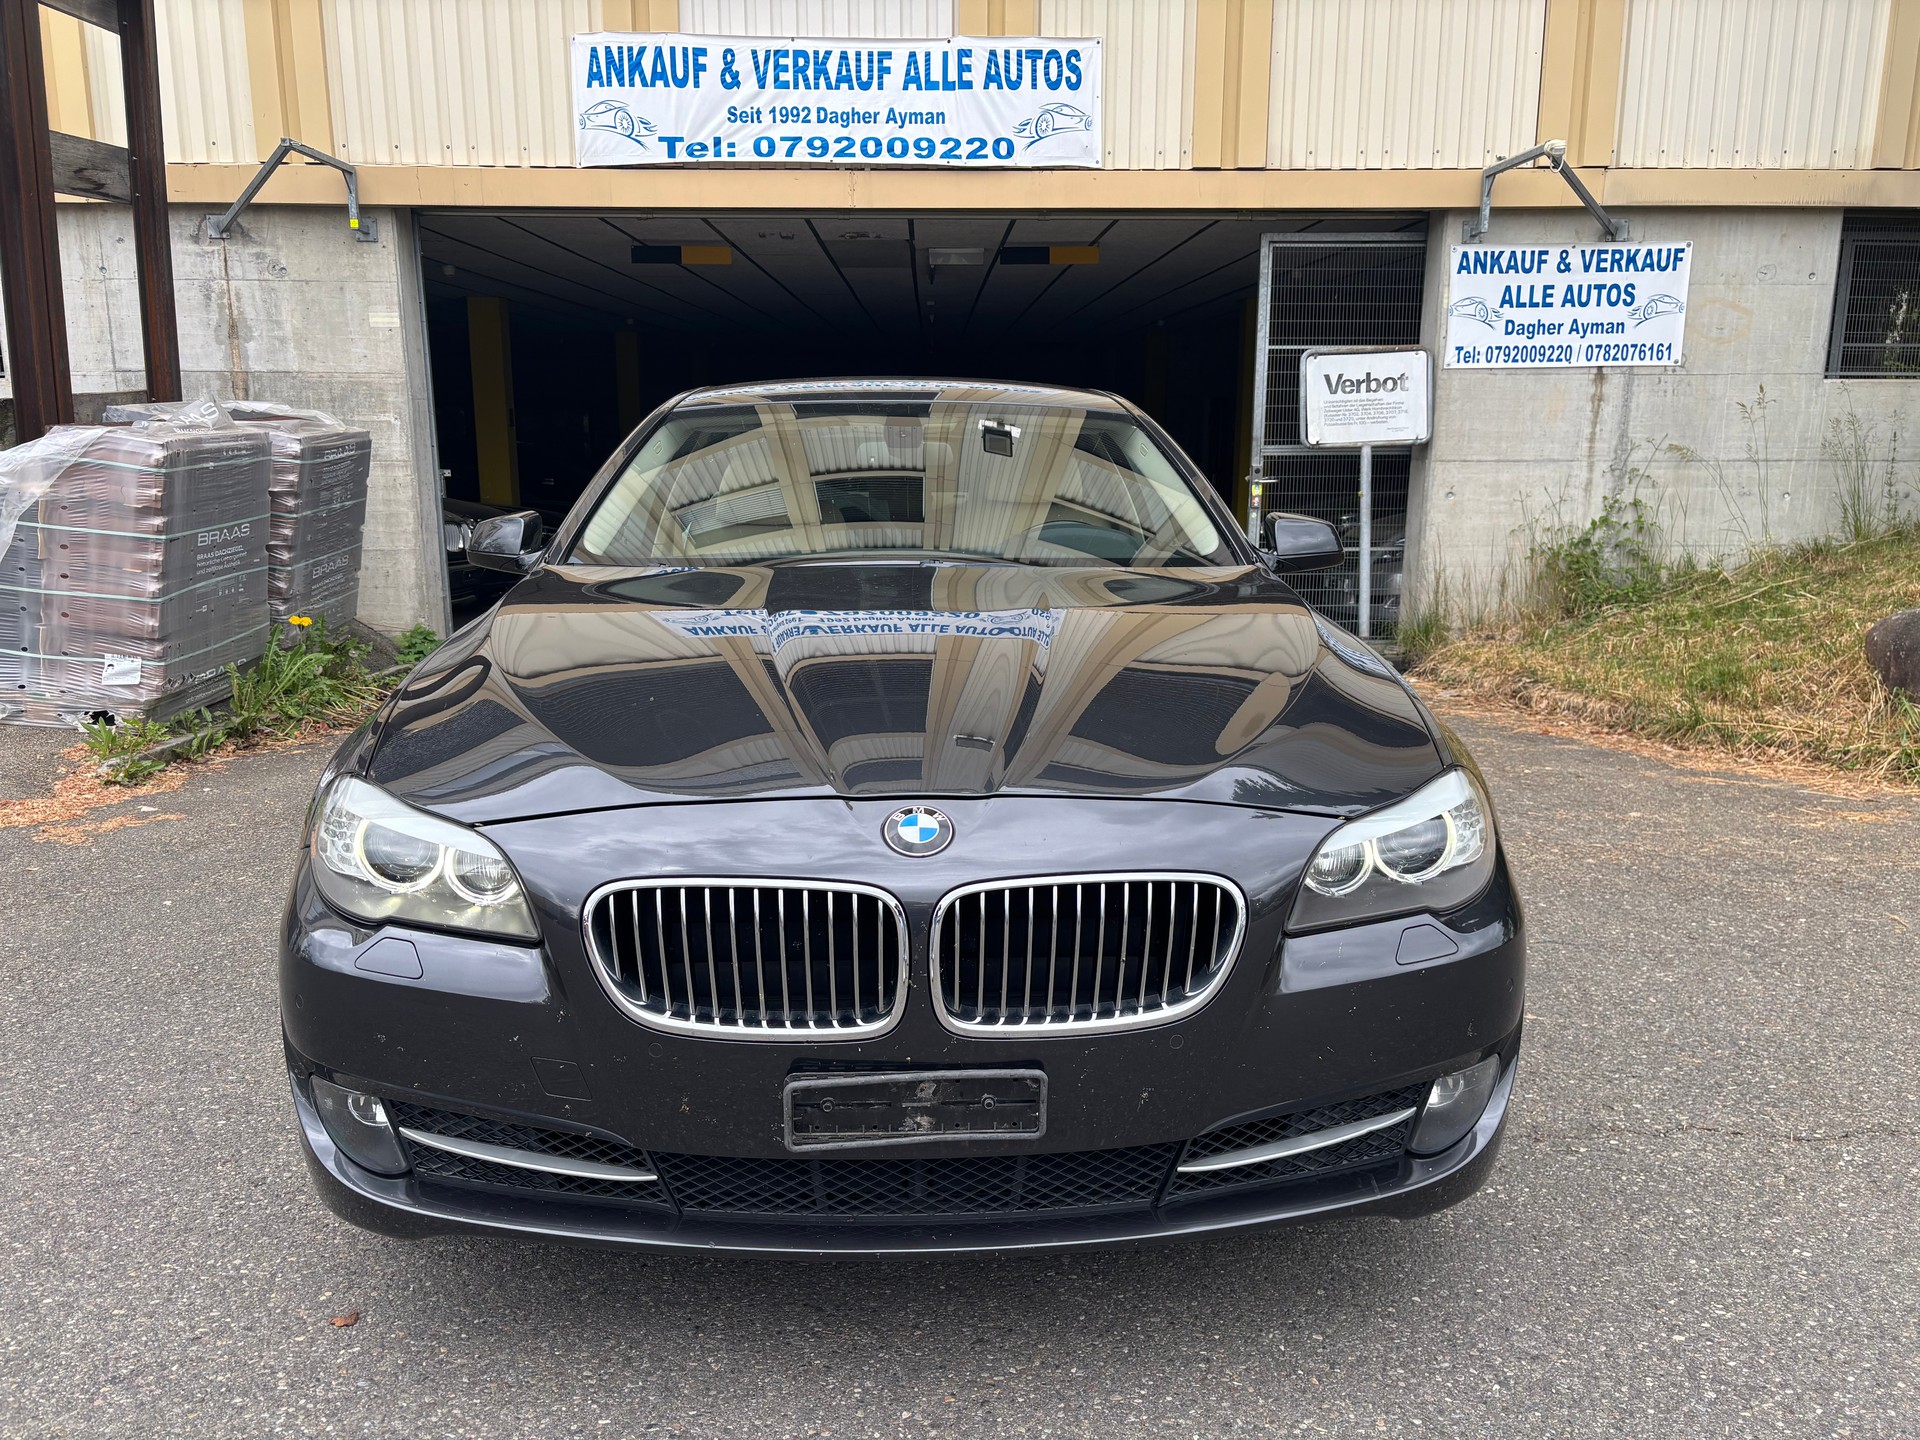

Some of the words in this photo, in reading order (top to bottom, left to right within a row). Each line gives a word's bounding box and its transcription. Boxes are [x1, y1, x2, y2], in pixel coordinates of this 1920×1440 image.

[586, 45, 708, 89] ANKAUF
[720, 47, 742, 90] &
[751, 48, 893, 91] VERKAUF
[902, 48, 973, 91] ALLE
[983, 48, 1083, 91] AUTOS
[727, 106, 762, 124] Seit
[769, 106, 811, 124] 1992
[816, 106, 880, 128] Dagher
[885, 107, 946, 129] Ayman
[658, 136, 736, 159] Tel:
[752, 136, 1015, 160] 0792009220
[1456, 250, 1549, 274] ANKAUF
[1556, 249, 1572, 273] &
[1581, 248, 1686, 273] VERKAUF
[1499, 284, 1555, 308] ALLE
[1561, 283, 1637, 308] AUTOS
[1504, 318, 1564, 340] Dagher
[1568, 318, 1625, 339] Ayman
[1454, 346, 1481, 364] Tel:
[1485, 344, 1572, 364] 0792009220
[1576, 344, 1582, 363] /
[1585, 342, 1672, 362] 0782076161
[1323, 372, 1409, 395] Verbot
[197, 523, 250, 546] BRAAS
[312, 554, 349, 579] BRAAS
[892, 807, 946, 821] BMW
